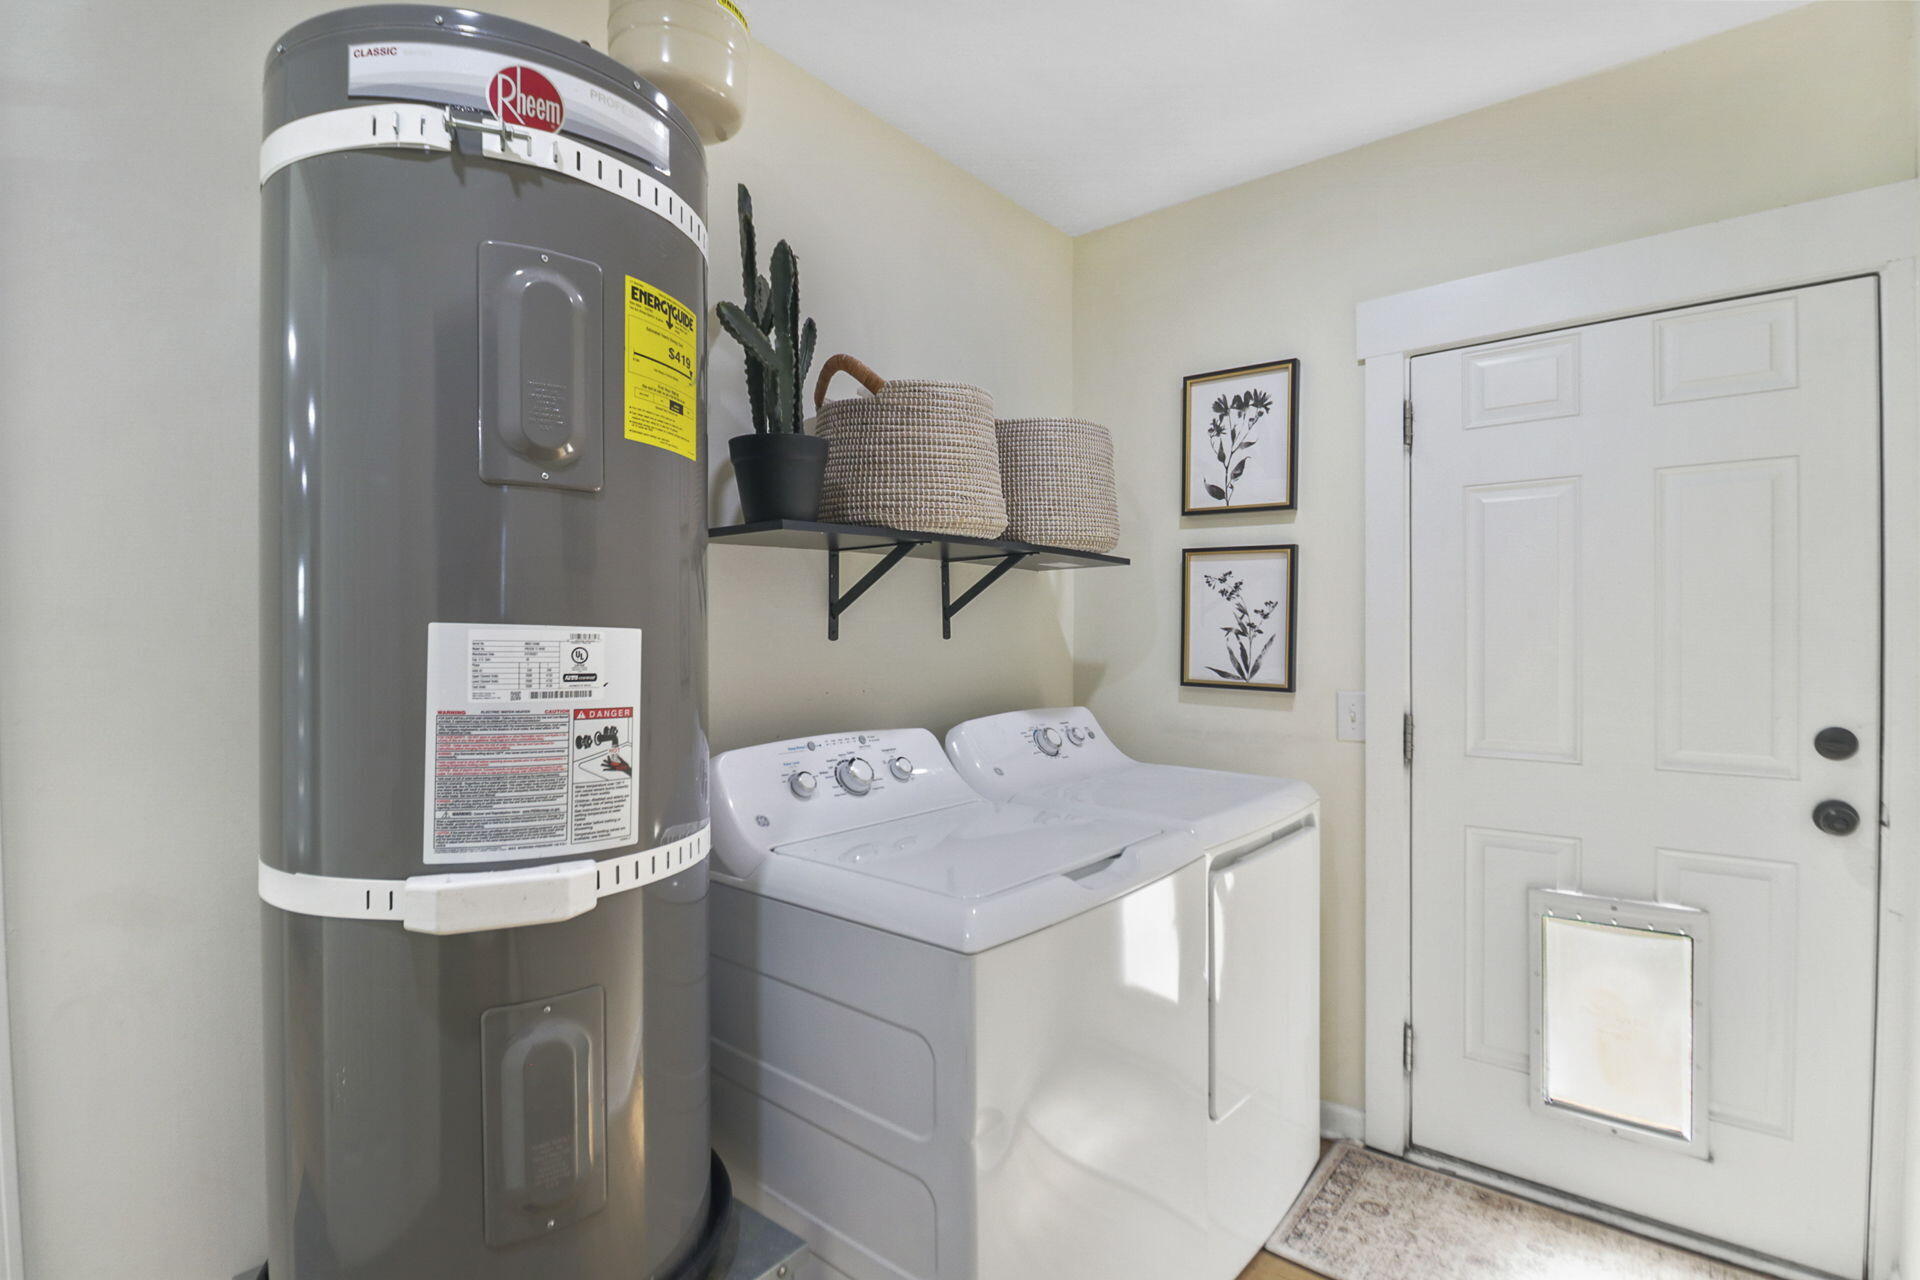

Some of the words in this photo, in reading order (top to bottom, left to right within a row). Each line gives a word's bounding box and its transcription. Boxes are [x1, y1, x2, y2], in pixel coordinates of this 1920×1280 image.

[353, 46, 398, 58] CLASSIC
[497, 65, 561, 125] Rheem
[631, 285, 694, 332] ENERGYGUIDE
[589, 709, 630, 718] DANGER
